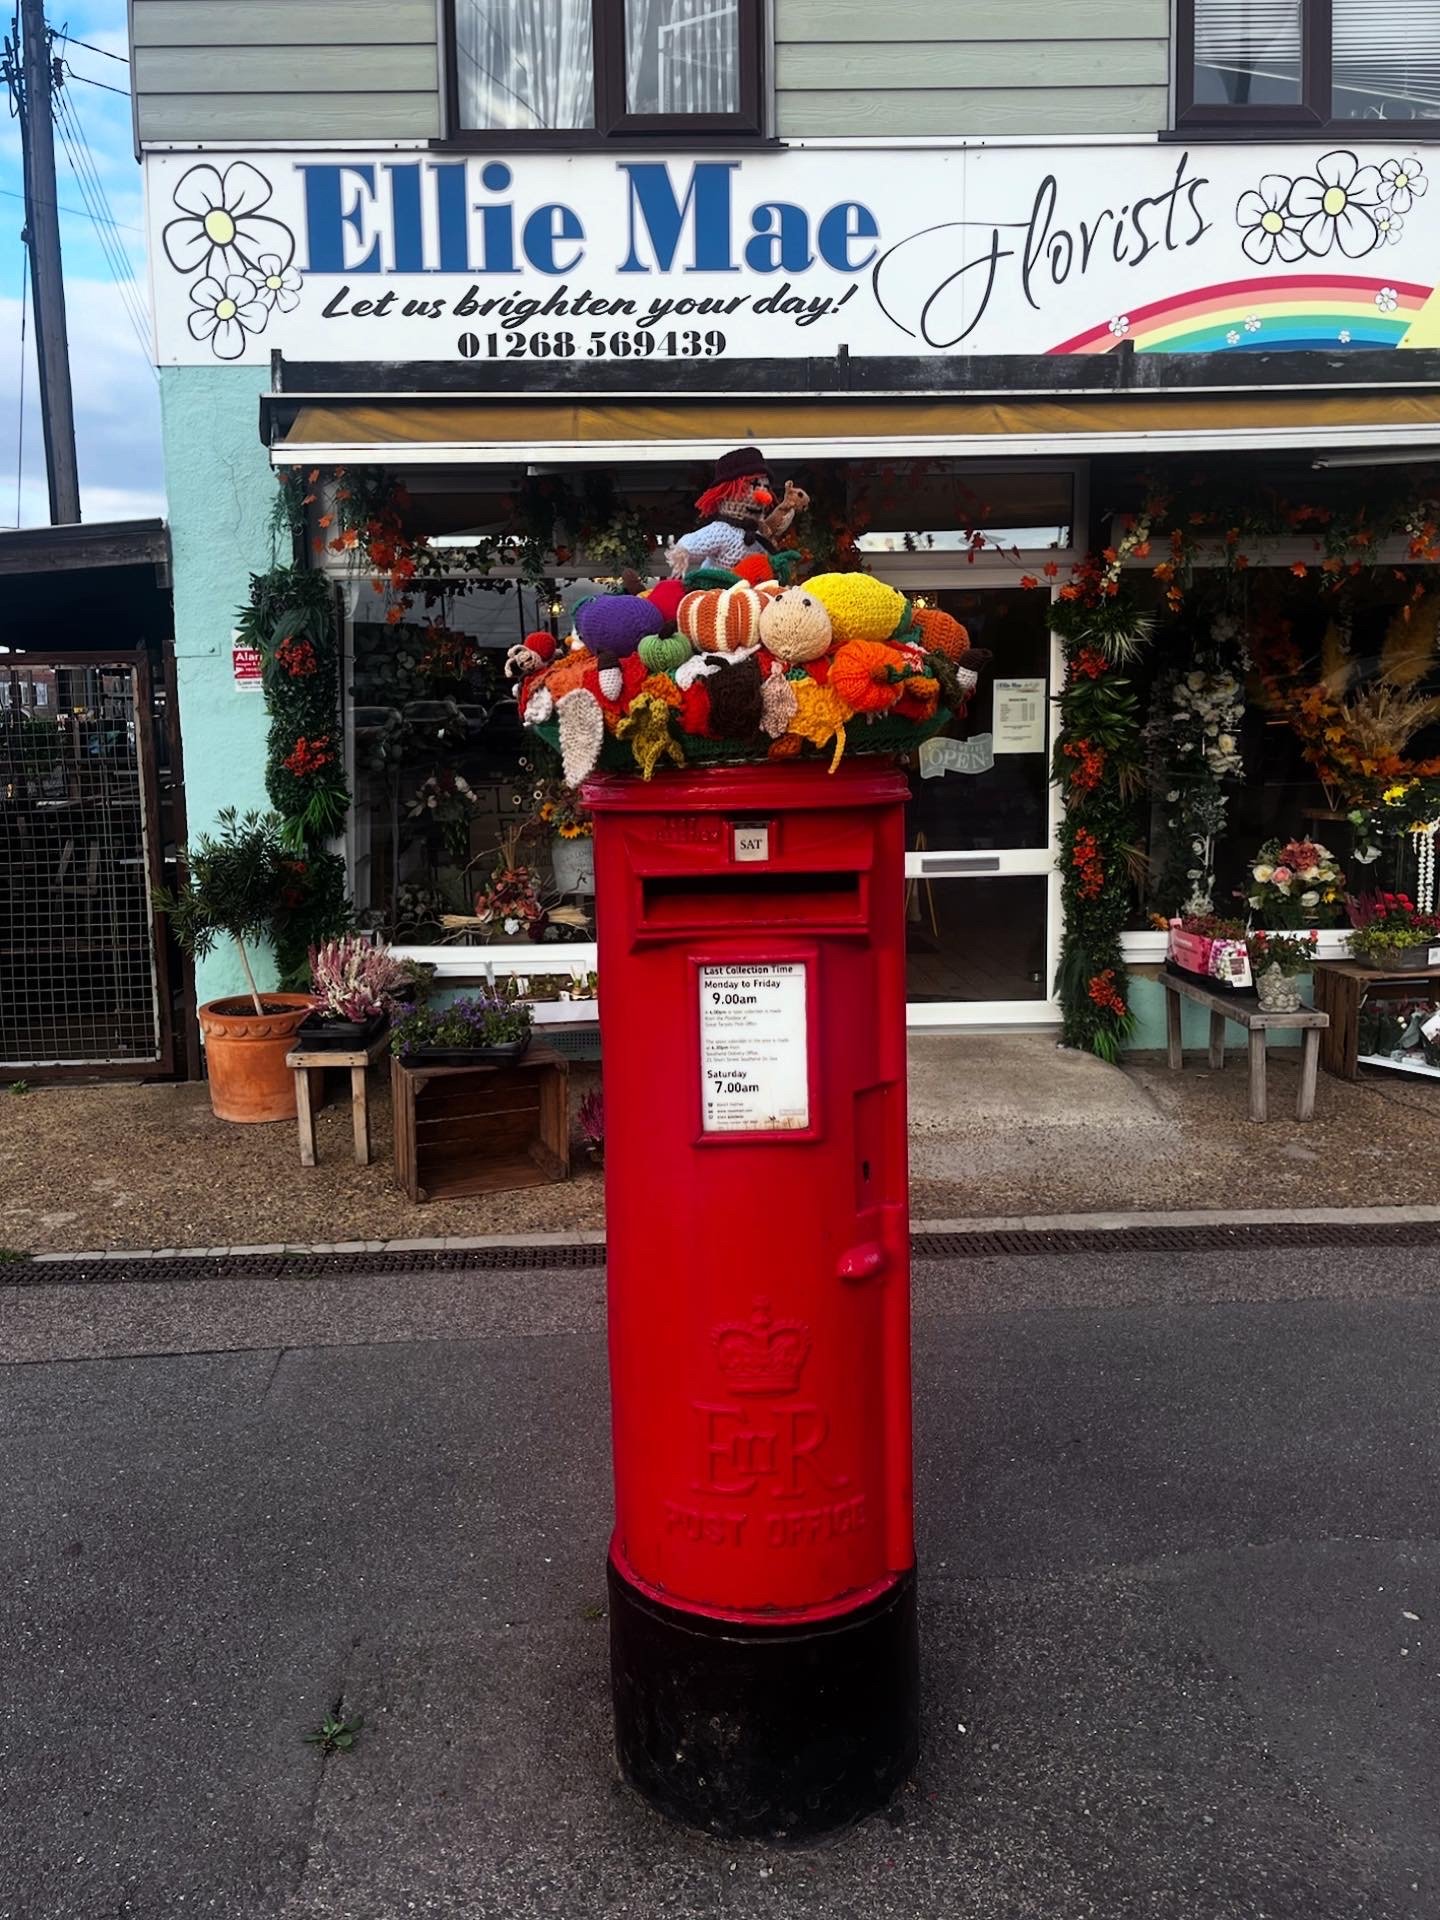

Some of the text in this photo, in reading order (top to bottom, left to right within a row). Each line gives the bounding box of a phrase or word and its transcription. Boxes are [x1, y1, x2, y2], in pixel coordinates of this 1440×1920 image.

[293, 158, 881, 276] Ellie Mae
[872, 152, 1211, 348] Florists
[322, 282, 858, 329] Let us brighten your day!
[458, 330, 727, 358] 01268 569439
[929, 748, 986, 769] OPEN
[740, 839, 763, 851] SAT
[704, 965, 793, 975] Last Collection Time
[704, 979, 781, 990] Monday to Friday
[712, 992, 757, 1005] 9.00am
[707, 1070, 747, 1079] Saturday
[715, 1080, 759, 1094] 7.00am
[664, 1495, 866, 1549] POST OFFICE
